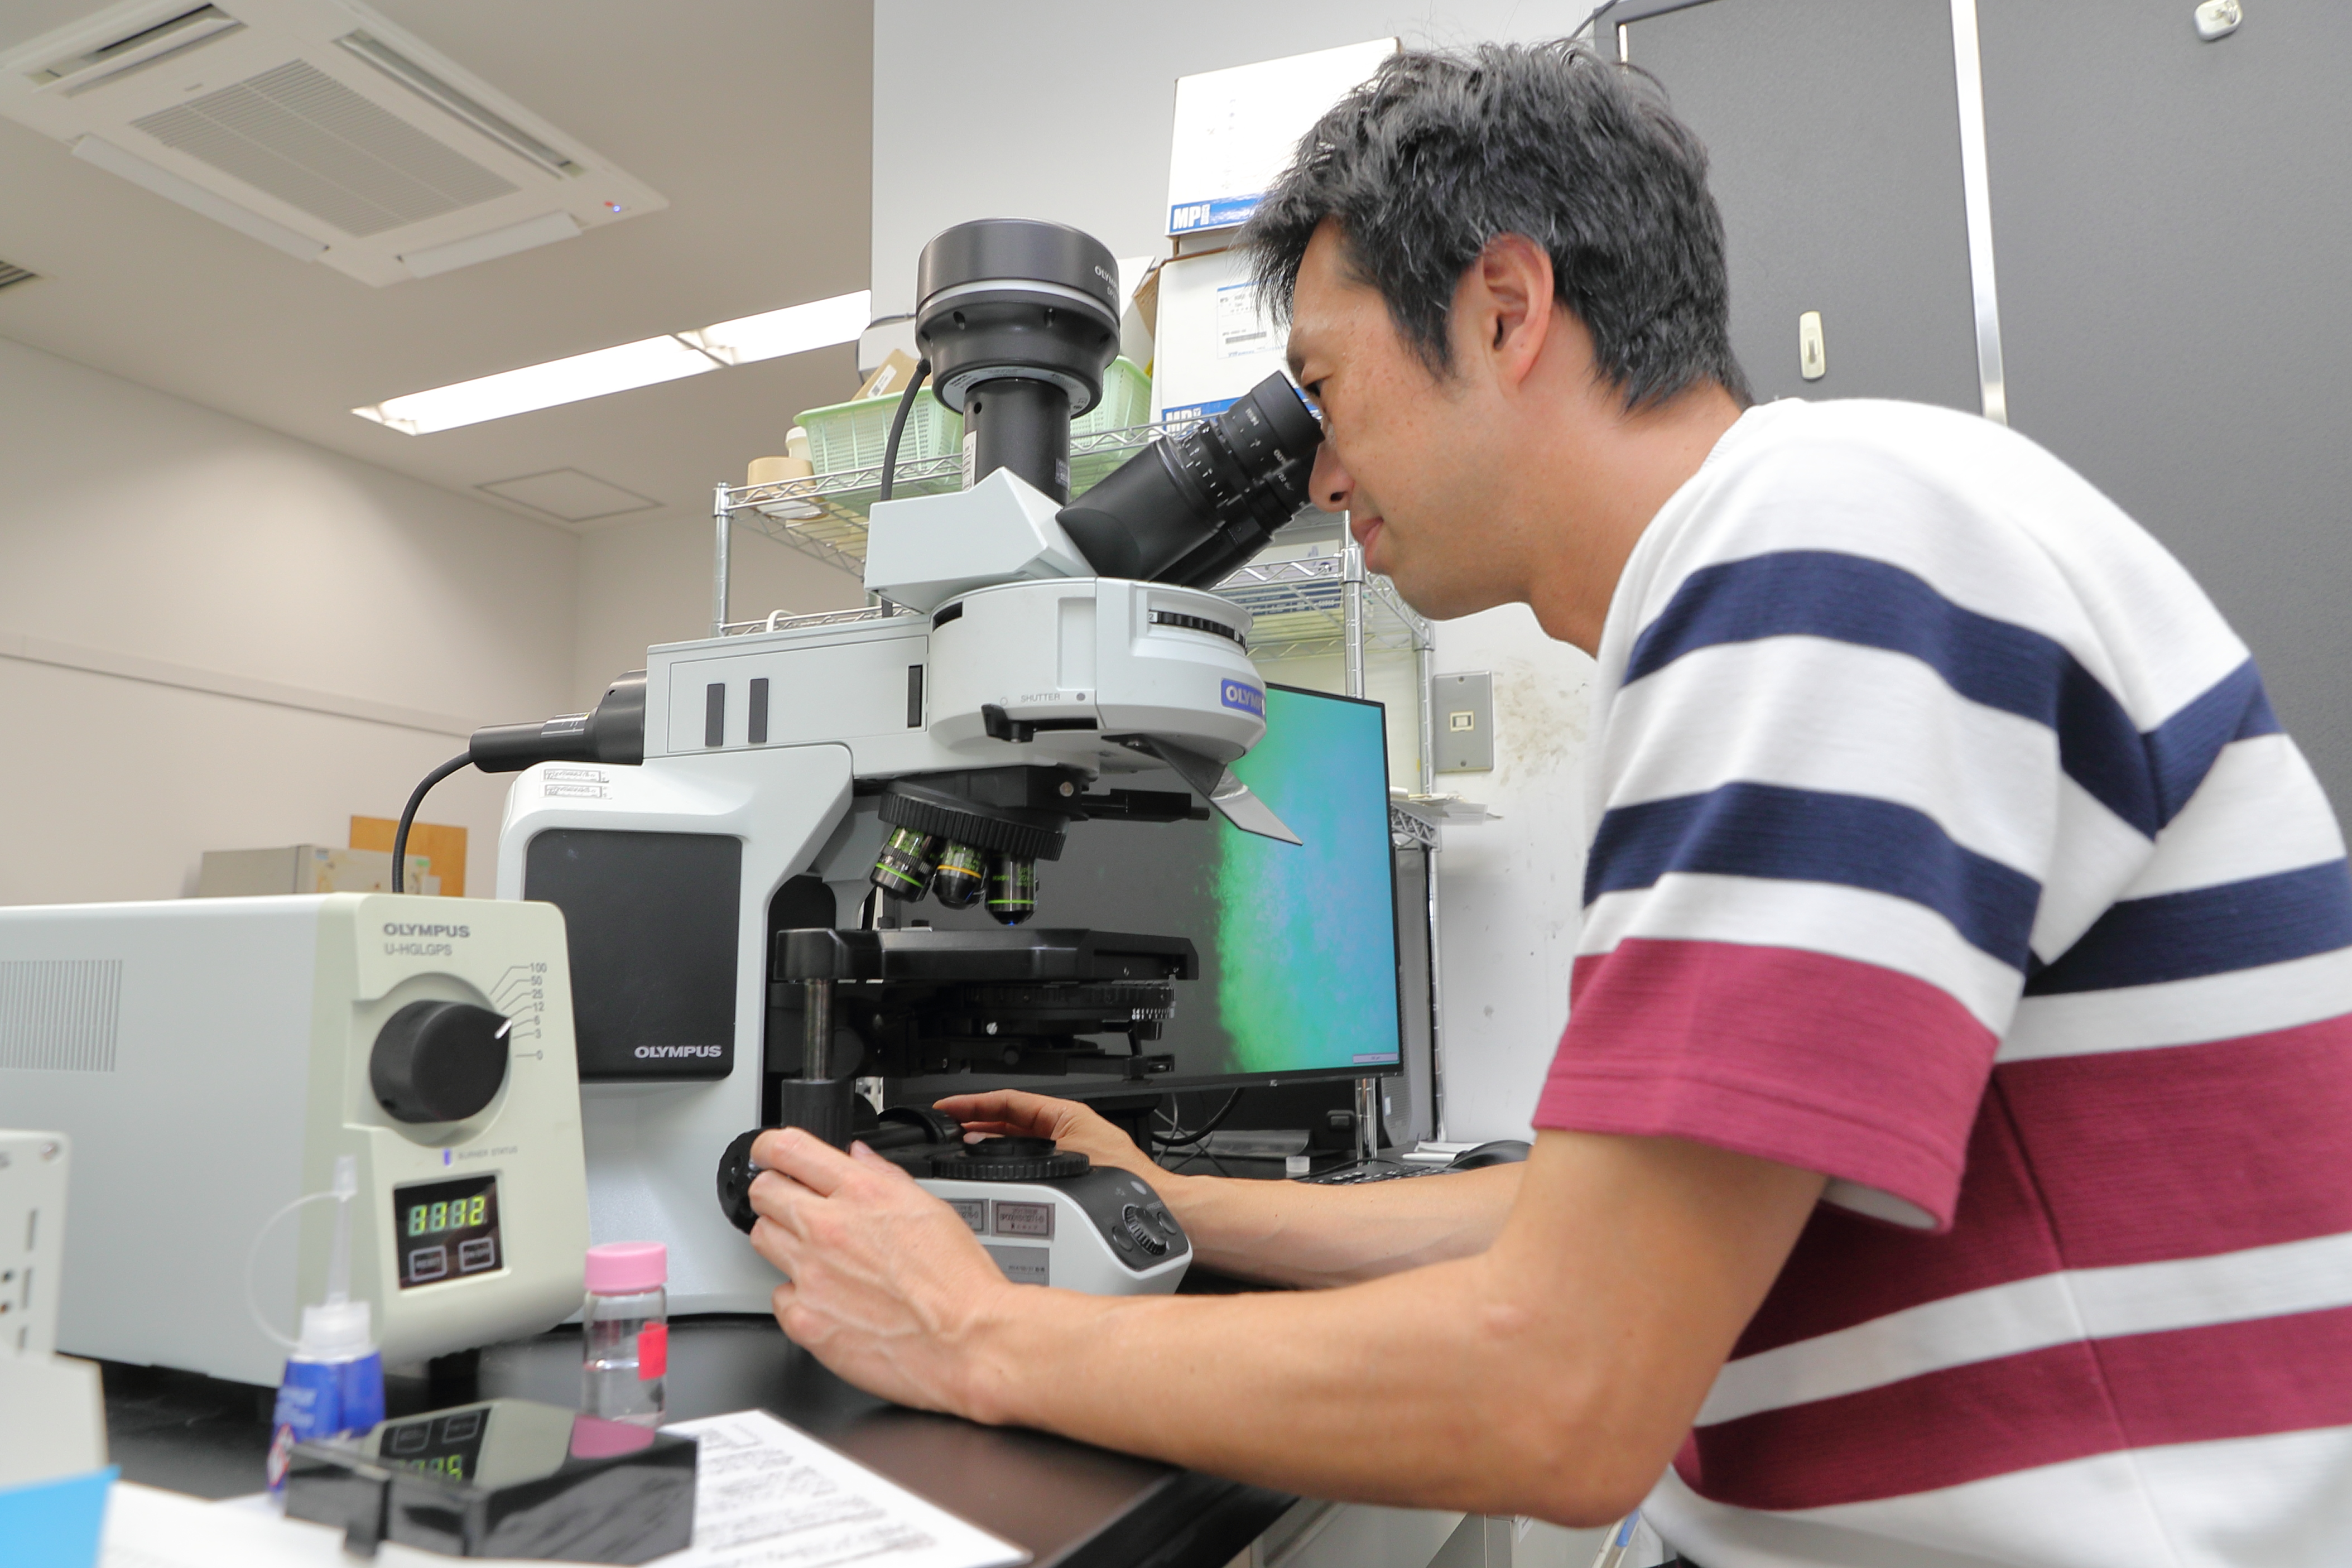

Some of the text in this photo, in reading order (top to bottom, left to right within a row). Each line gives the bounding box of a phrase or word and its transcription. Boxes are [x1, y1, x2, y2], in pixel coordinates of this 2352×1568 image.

[1021, 692, 1060, 703] SHUTTER
[383, 923, 470, 938] OLYMPUS
[530, 963, 547, 973] 100
[531, 976, 542, 986] 50
[532, 989, 543, 999] 25
[533, 1002, 544, 1012] 12
[534, 1015, 540, 1025] 6
[535, 1029, 541, 1038] 3
[537, 1050, 543, 1060] 0
[634, 1045, 723, 1058] OLYMPUS
